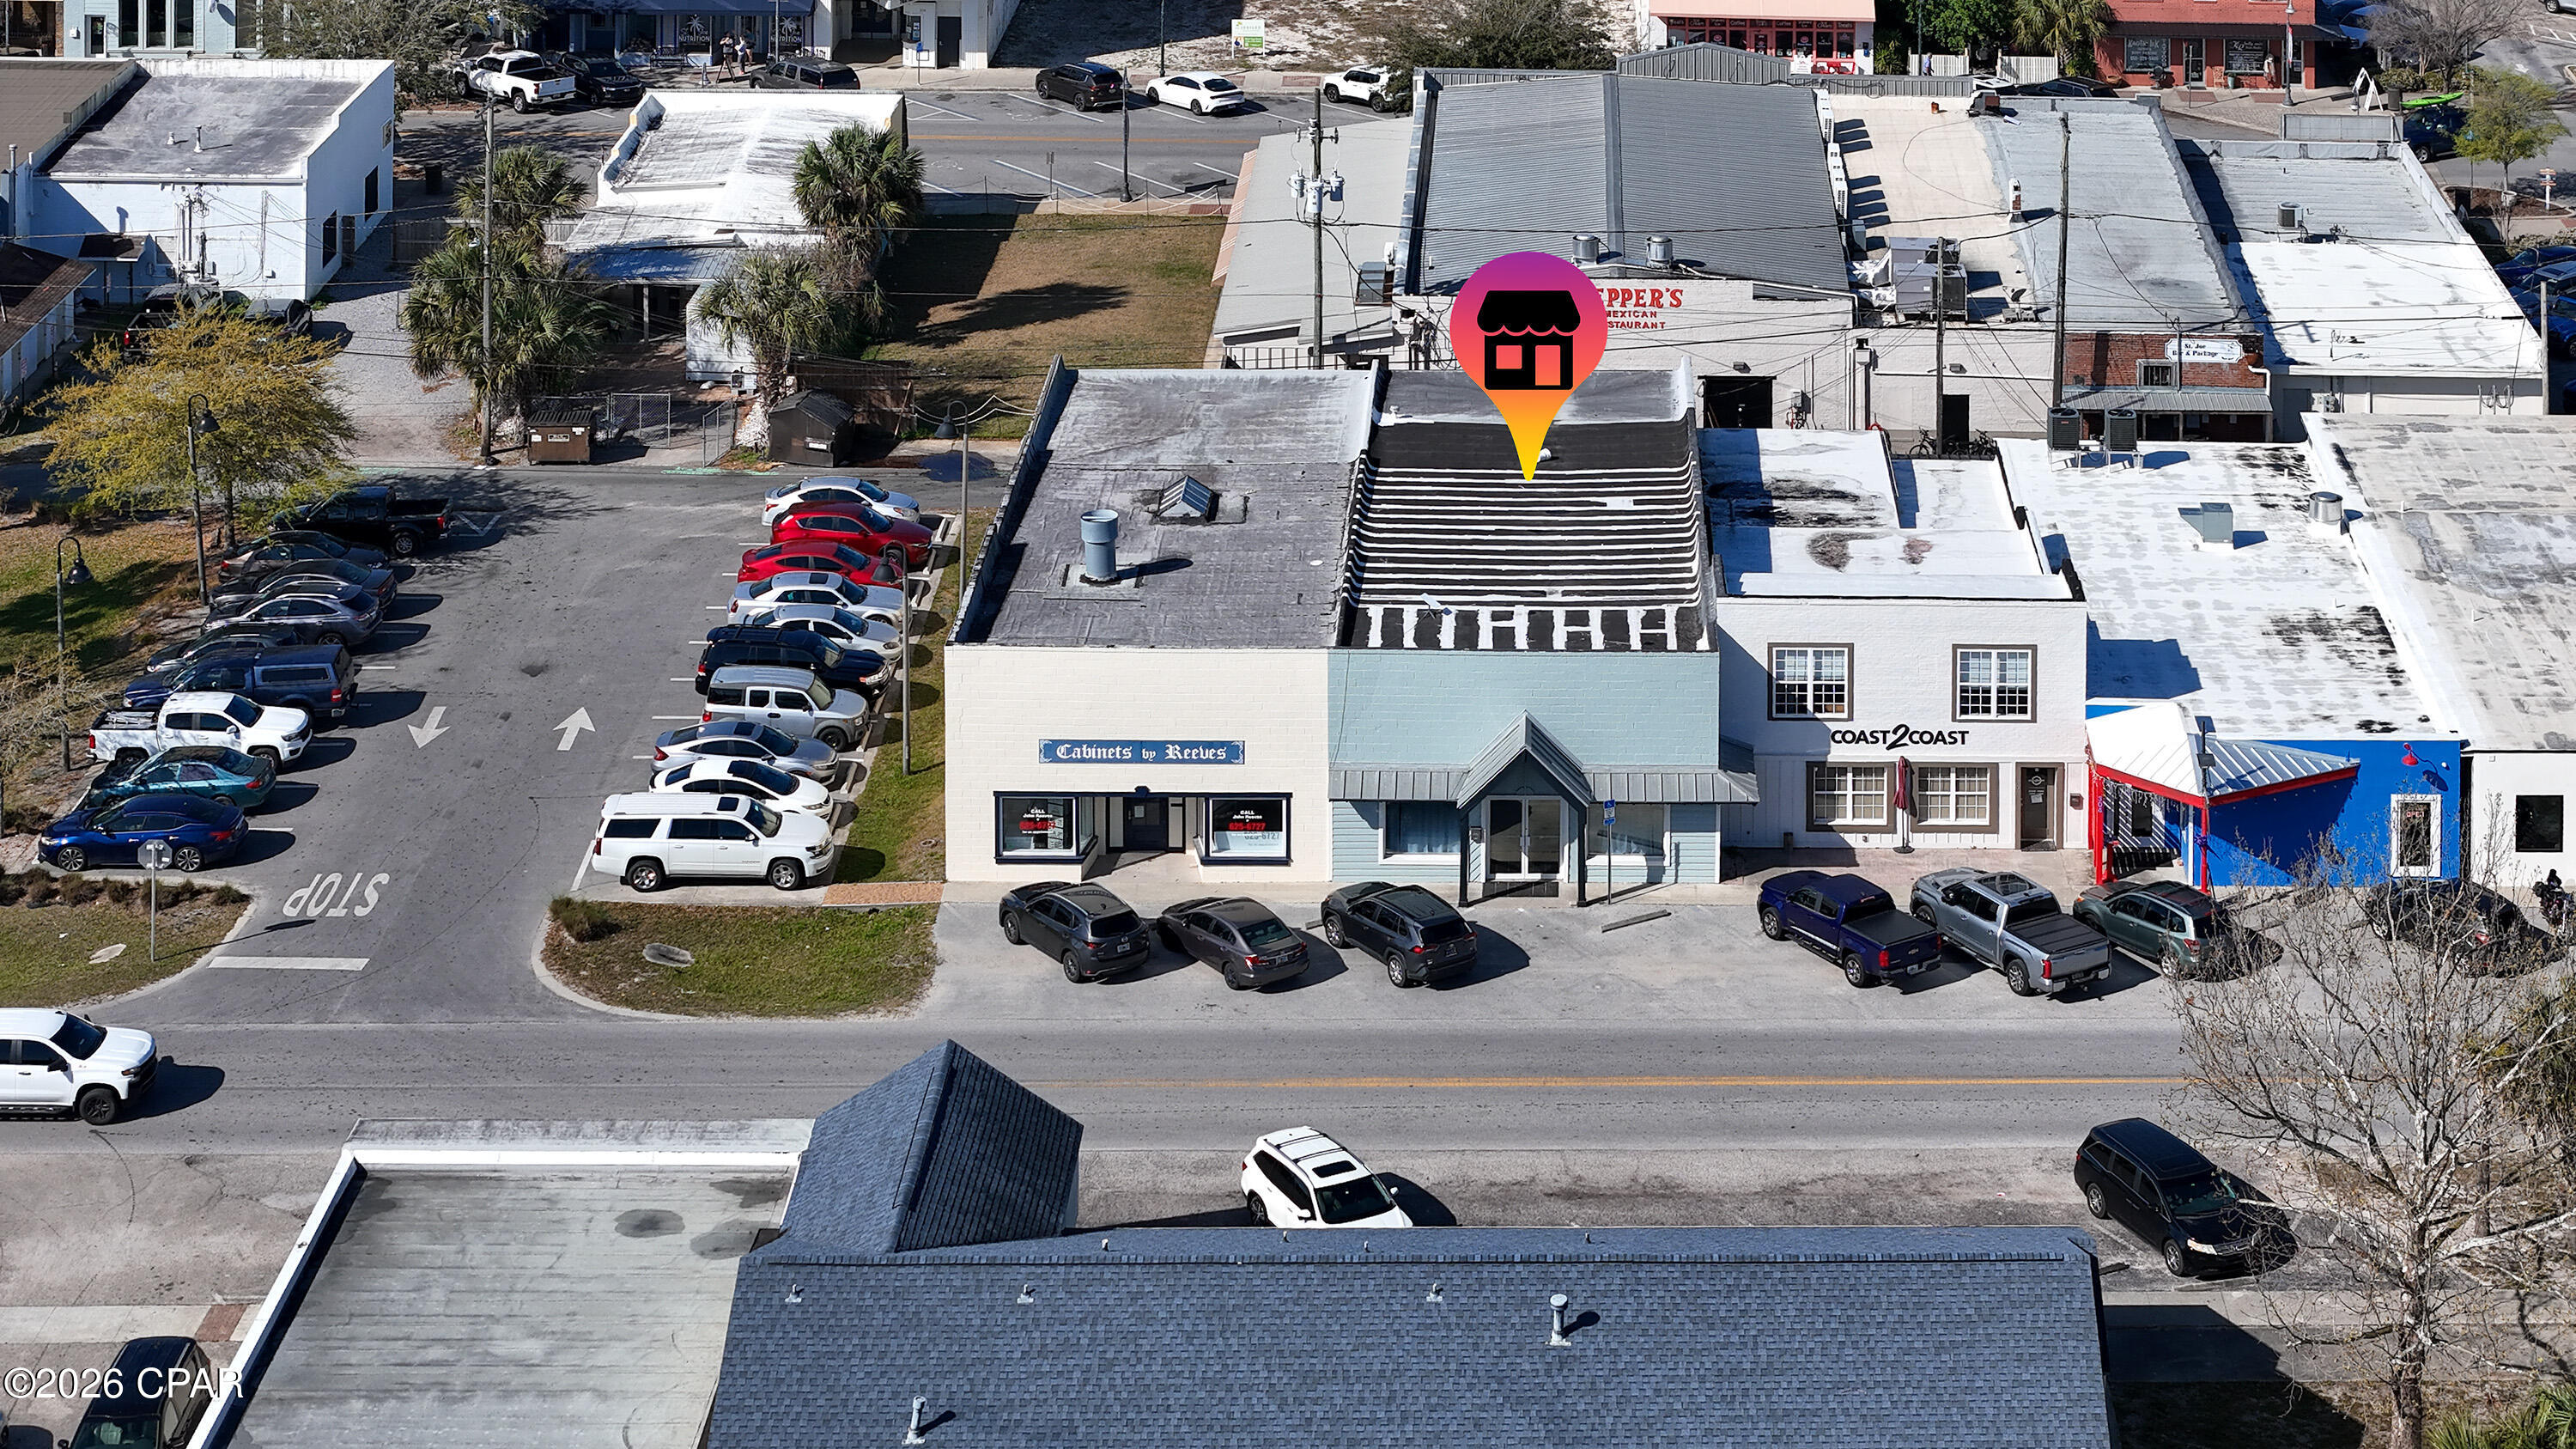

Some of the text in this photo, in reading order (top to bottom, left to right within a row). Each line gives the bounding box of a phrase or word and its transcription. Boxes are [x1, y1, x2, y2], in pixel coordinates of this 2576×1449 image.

[1596, 288, 1684, 308] PPER'S
[1056, 744, 1226, 761] Cabinets by Reeves
[1229, 822, 1266, 831] 625-6727
[282, 872, 390, 916] STOP
